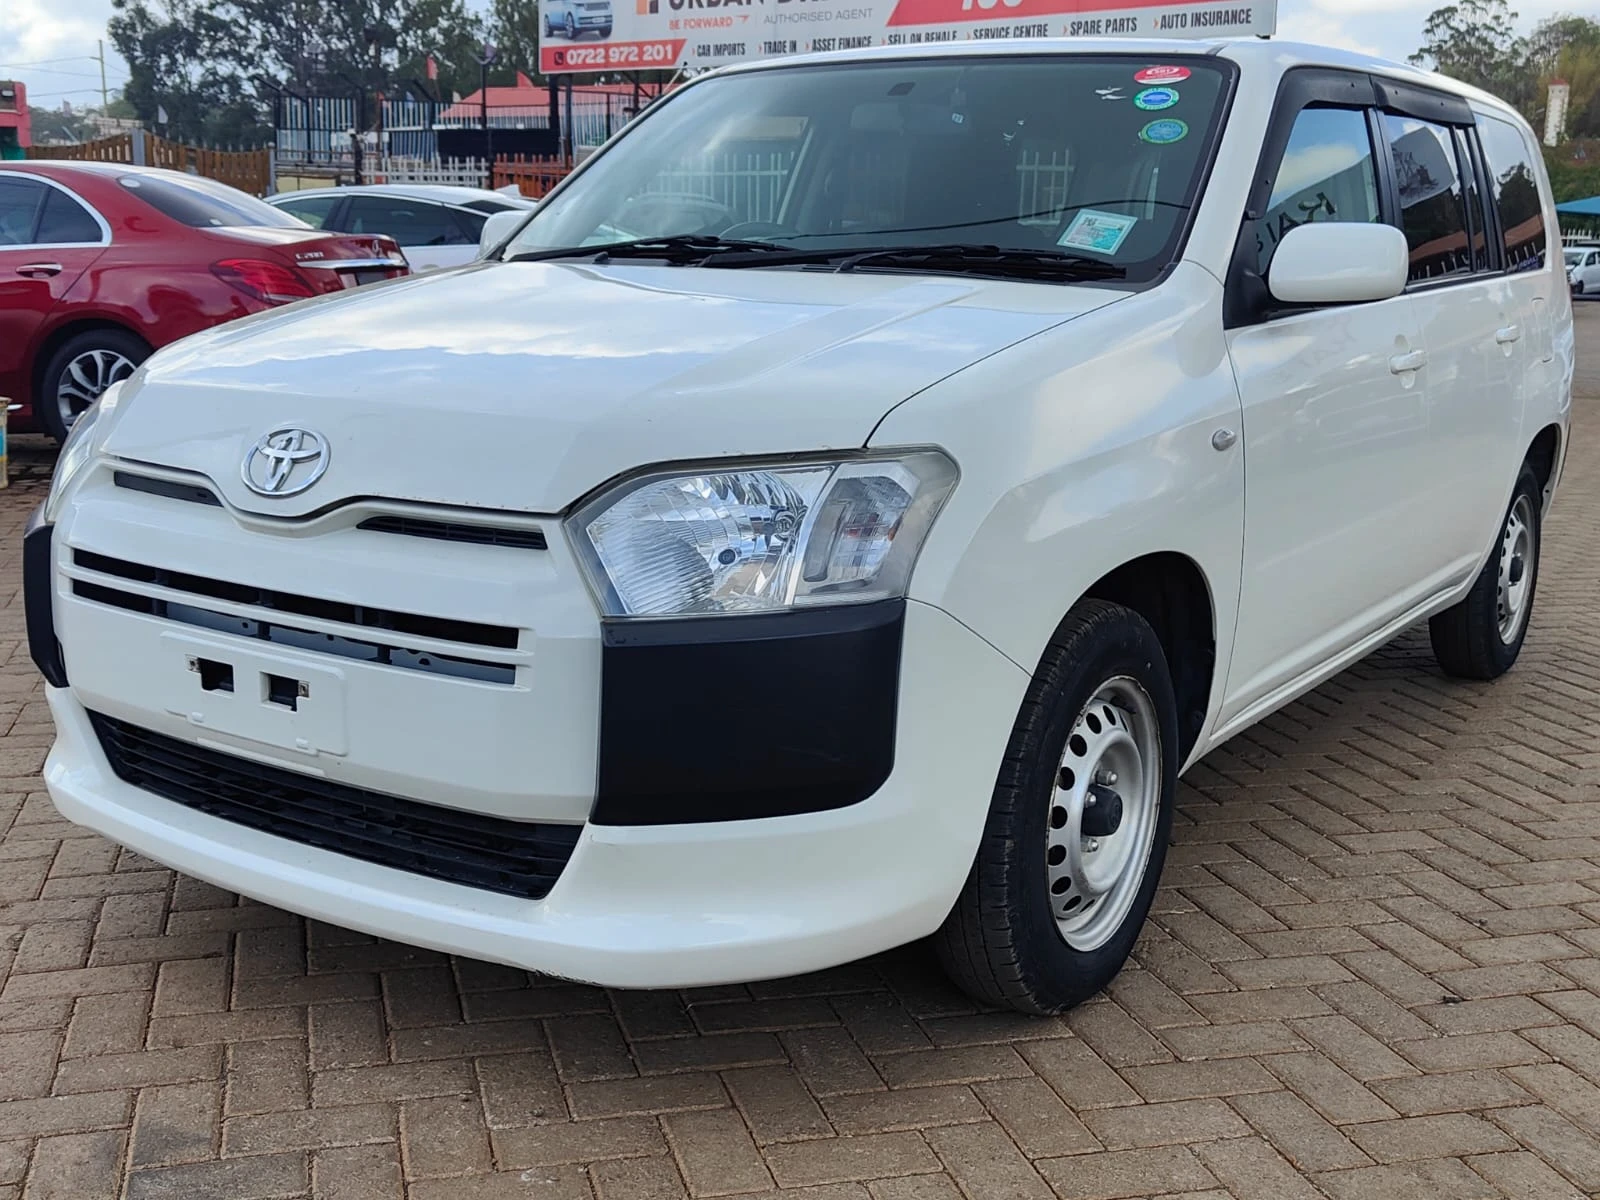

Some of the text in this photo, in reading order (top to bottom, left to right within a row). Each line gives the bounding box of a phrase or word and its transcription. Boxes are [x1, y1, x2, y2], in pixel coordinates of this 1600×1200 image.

[669, 16, 733, 30] BE FORWARD
[763, 8, 873, 24] AUTHORISED AGENT
[697, 44, 711, 57] CAR
[713, 42, 746, 56] IMPORTS
[763, 40, 787, 54] TRADE
[789, 40, 797, 53] IN
[812, 38, 836, 52] ASSET
[838, 35, 872, 50] FINANCE
[973, 26, 1010, 40] SERVICE
[1013, 24, 1049, 38] CENTRE
[1070, 19, 1102, 36] SPARE
[1105, 17, 1137, 33] PARTS
[1160, 13, 1187, 30] AUTO
[1190, 8, 1252, 28] INSURANCE
[566, 44, 673, 65] 0722 972 201
